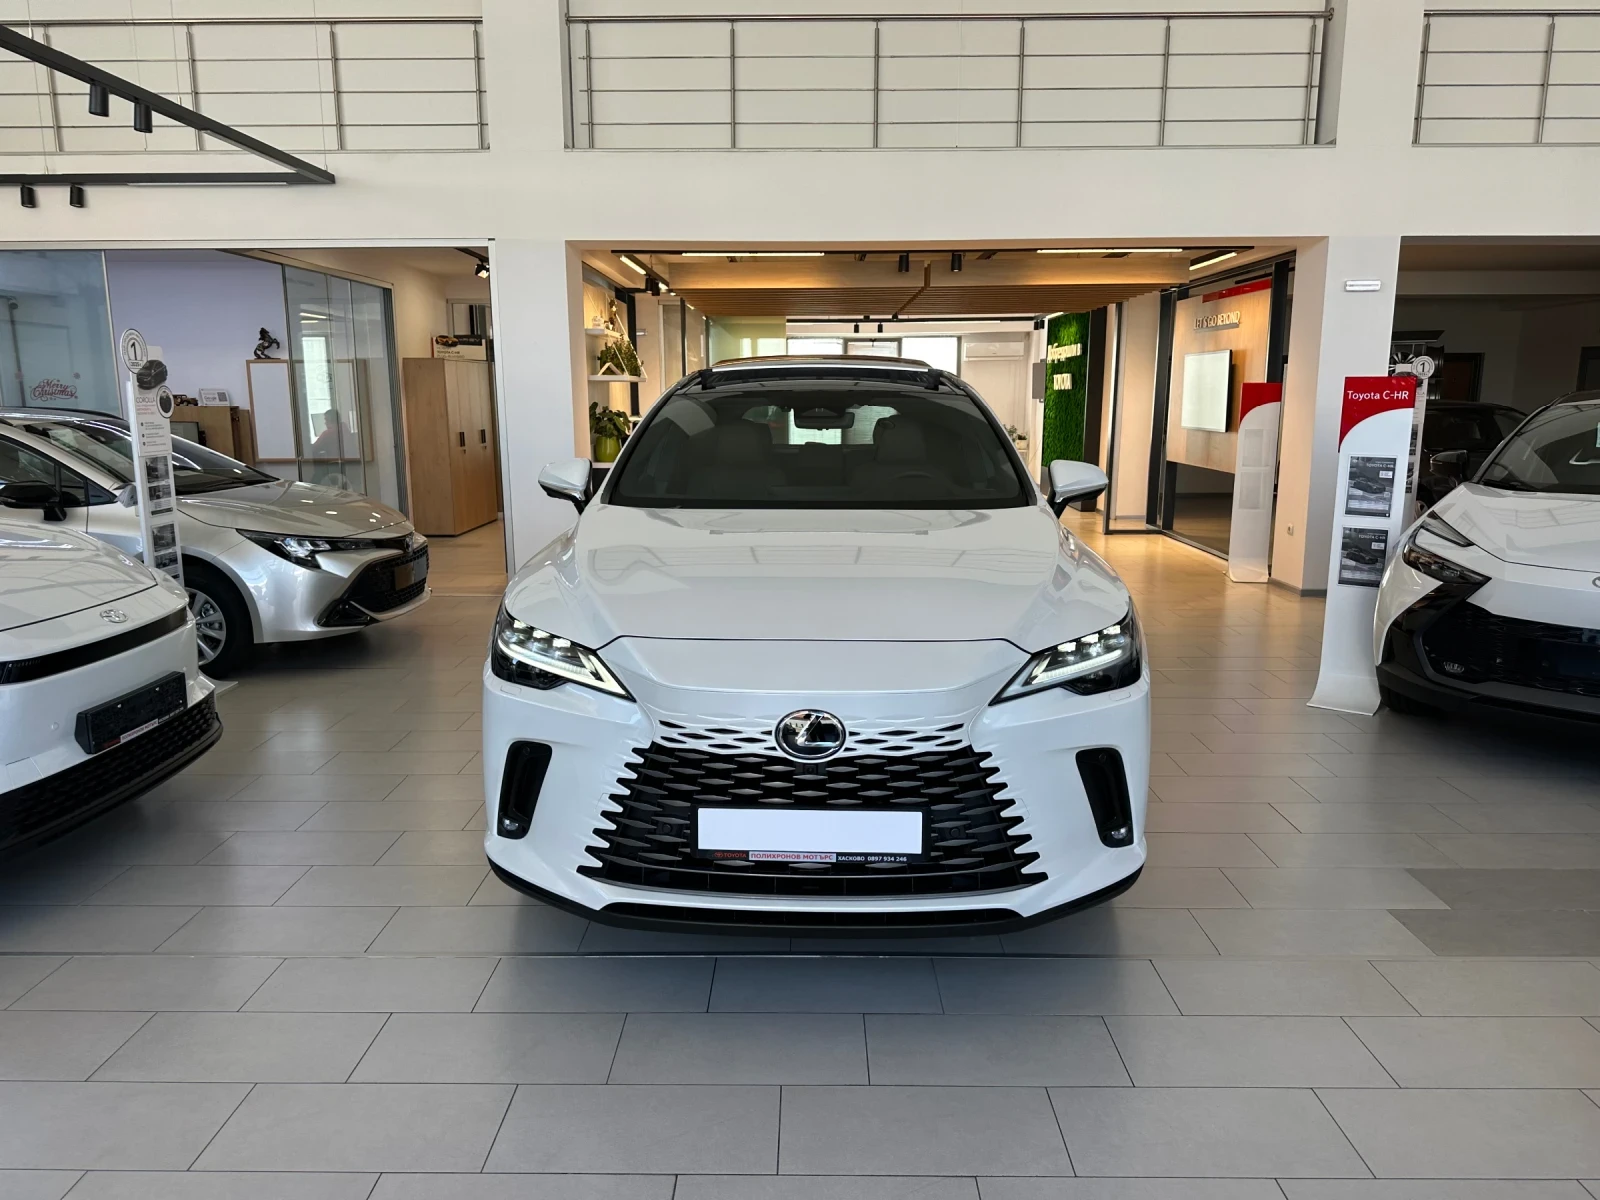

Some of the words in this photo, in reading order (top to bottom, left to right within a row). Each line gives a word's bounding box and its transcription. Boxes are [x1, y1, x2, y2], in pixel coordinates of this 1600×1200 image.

[1217, 311, 1241, 326] BEYOND
[136, 396, 156, 404] COROLLA
[1347, 390, 1380, 402] Toyota
[1382, 390, 1409, 400] C-HR
